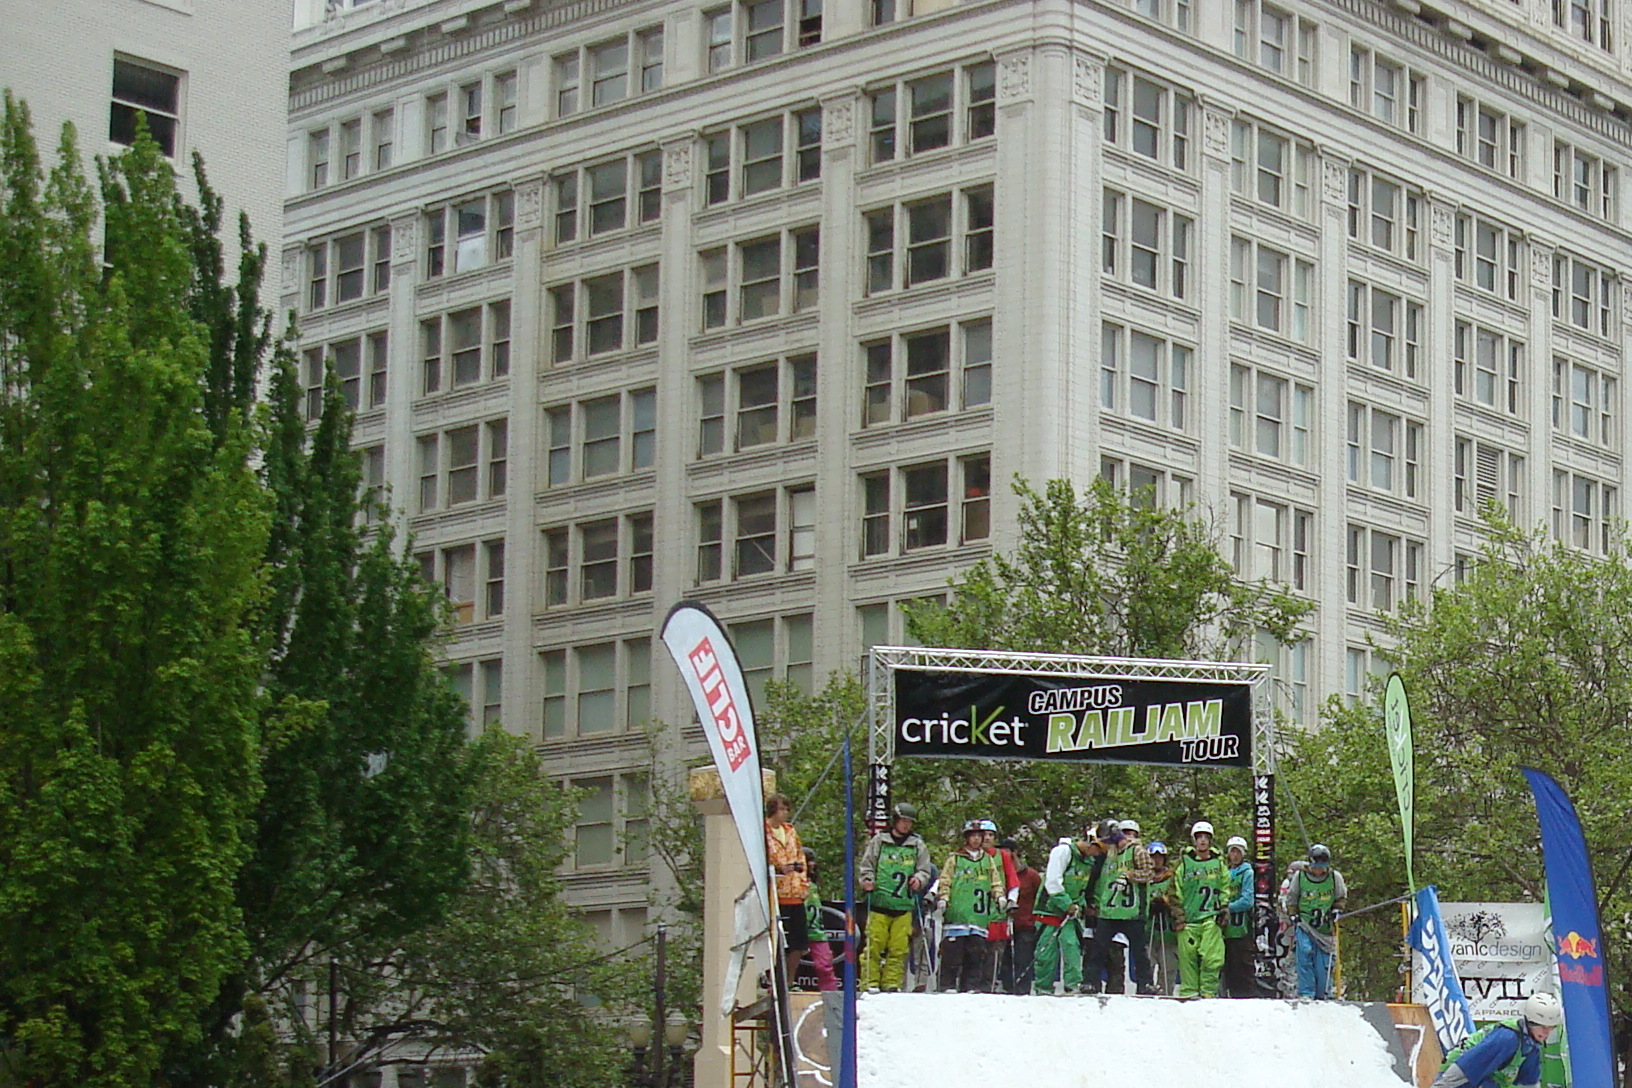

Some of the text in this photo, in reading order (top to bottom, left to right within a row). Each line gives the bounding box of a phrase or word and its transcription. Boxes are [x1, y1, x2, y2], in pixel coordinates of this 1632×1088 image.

[692, 649, 738, 742] CLIF
[1028, 685, 1122, 714] CAMPUS
[901, 704, 1026, 746] cricket
[1046, 699, 1223, 753] RAILJAM
[726, 735, 747, 763] BAR
[1180, 735, 1239, 763] TOUR
